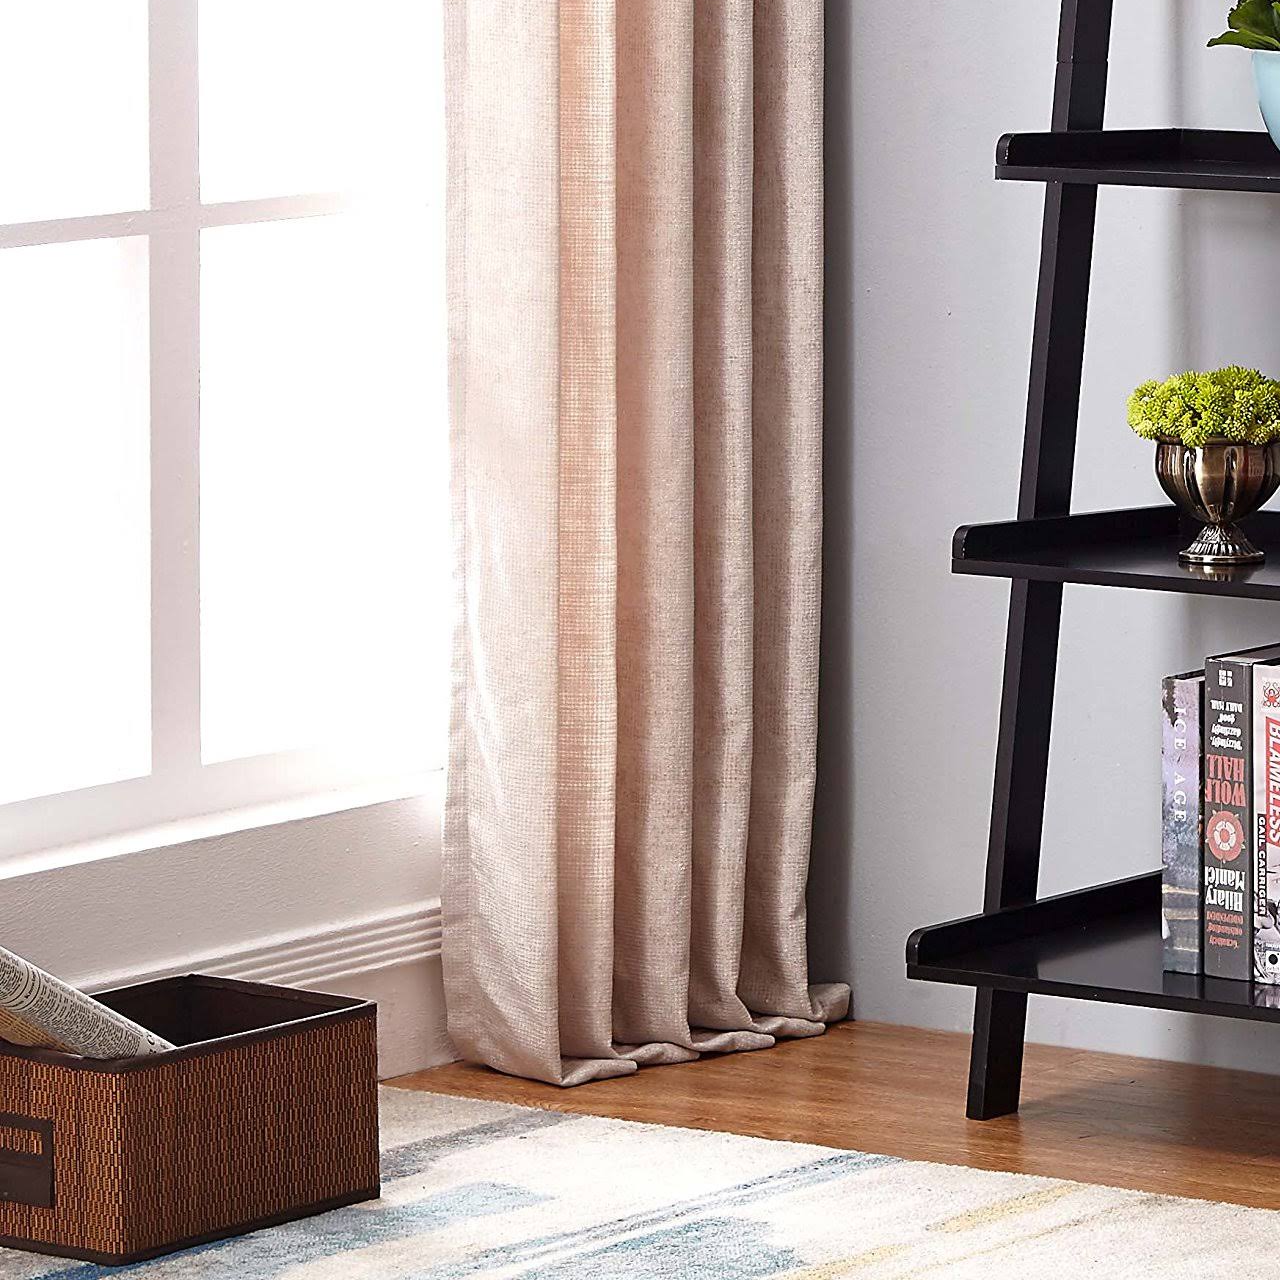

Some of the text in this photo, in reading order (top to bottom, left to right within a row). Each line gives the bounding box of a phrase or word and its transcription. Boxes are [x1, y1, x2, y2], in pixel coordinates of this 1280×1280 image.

[1173, 707, 1187, 822] ICE AGE
[1206, 754, 1246, 780] HALL
[1205, 884, 1244, 912] Hilary
[1257, 816, 1267, 917] GAIL CARRIGER
